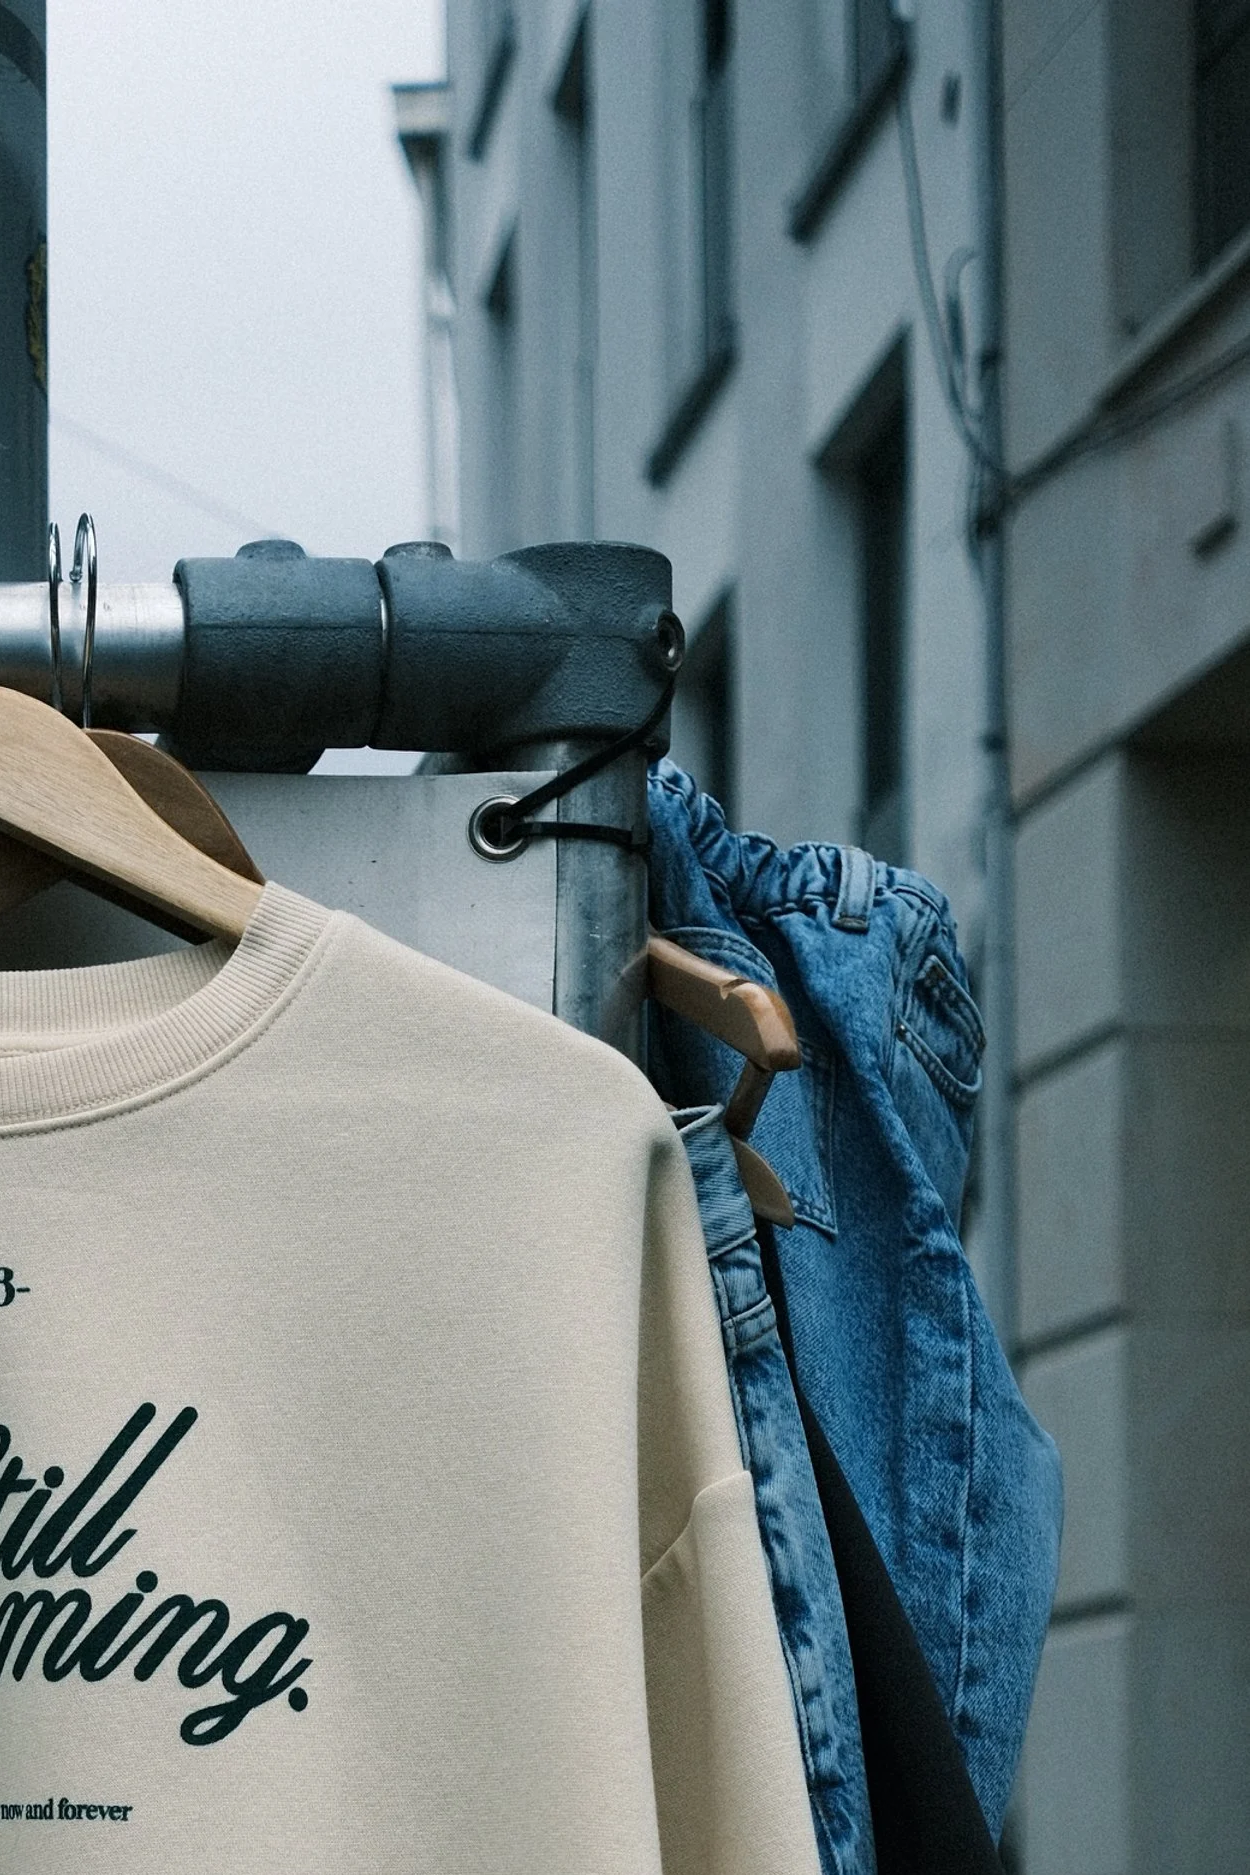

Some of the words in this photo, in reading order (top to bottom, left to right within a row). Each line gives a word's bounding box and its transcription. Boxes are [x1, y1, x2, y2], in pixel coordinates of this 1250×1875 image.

[0, 1803, 25, 1821] now
[25, 1797, 55, 1821] and
[56, 1796, 135, 1823] forever
